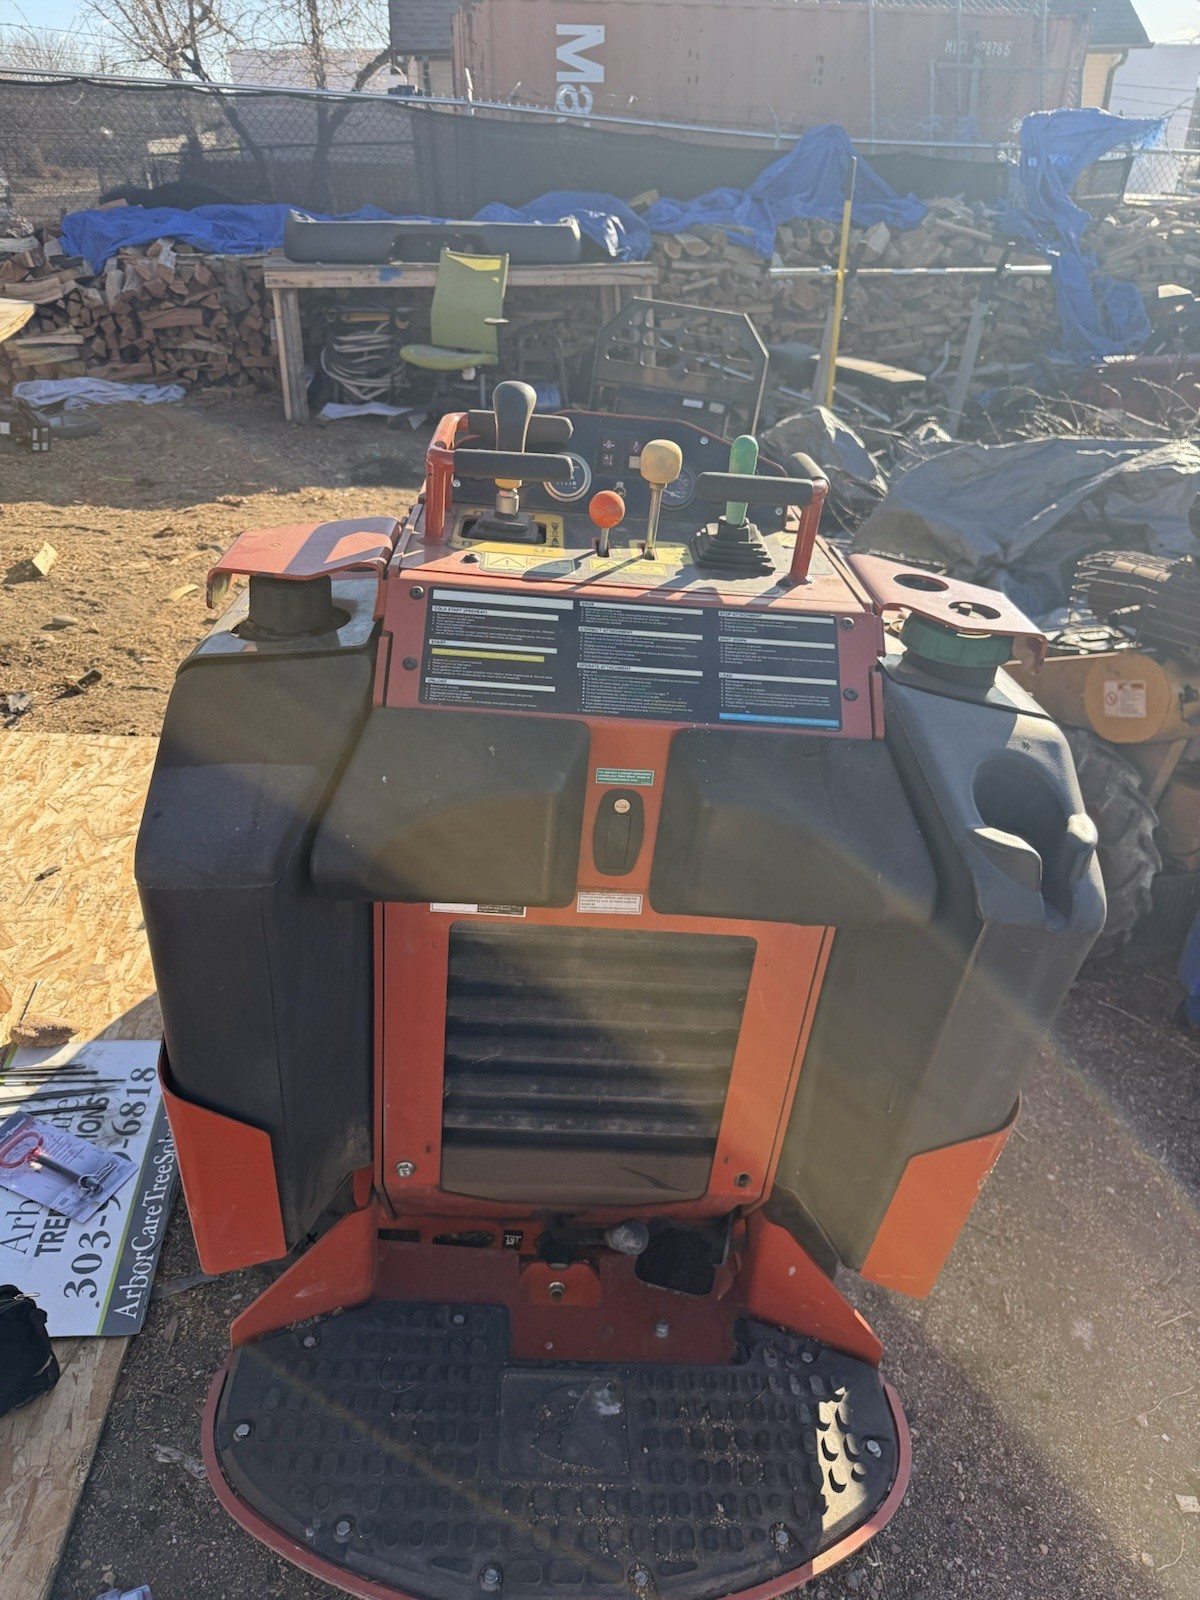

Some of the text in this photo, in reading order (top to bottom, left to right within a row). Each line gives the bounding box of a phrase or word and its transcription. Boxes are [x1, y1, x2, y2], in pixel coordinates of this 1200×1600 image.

[63, 1066, 157, 1299] 303--6818
[0, 1199, 43, 1255] Arb
[34, 1208, 71, 1258] TRE
